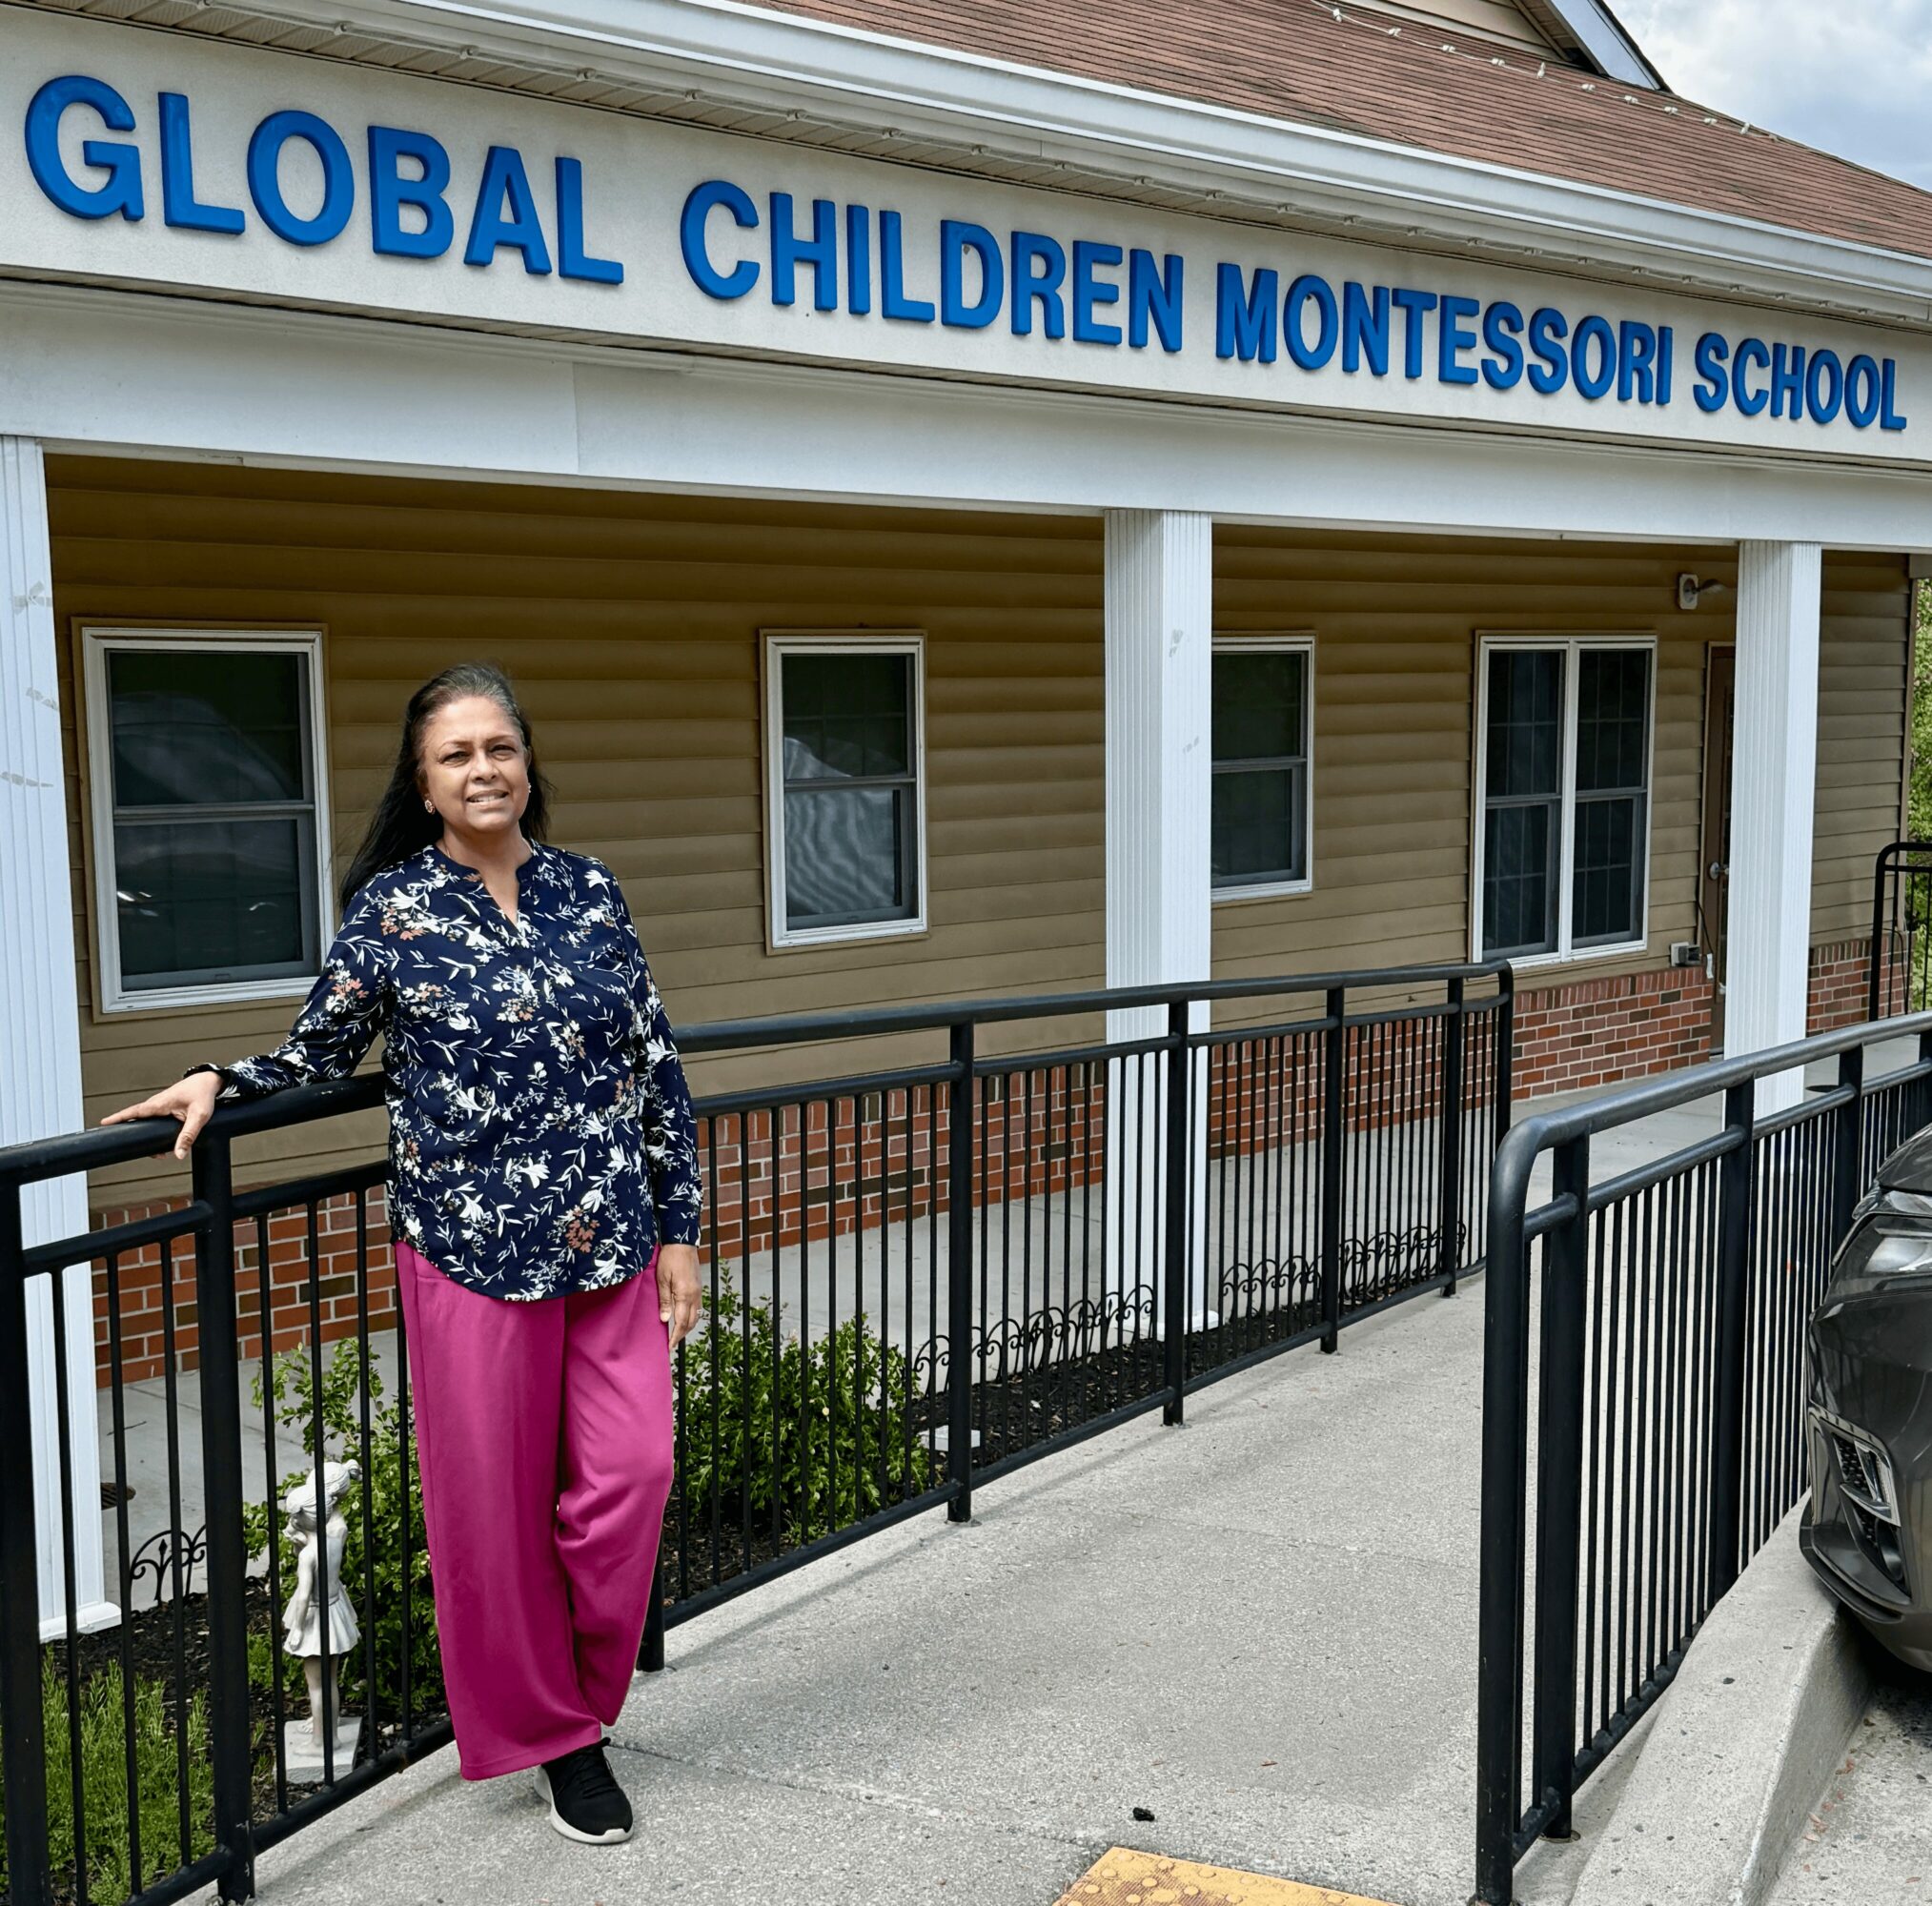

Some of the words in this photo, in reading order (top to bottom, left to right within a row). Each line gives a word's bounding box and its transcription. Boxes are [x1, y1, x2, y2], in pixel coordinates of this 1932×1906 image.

[25, 74, 624, 286] GLOBAL
[680, 179, 1184, 354] CHILDREN
[1215, 262, 1674, 406] MONTESSORI
[1692, 332, 1907, 432] SCHOOL
